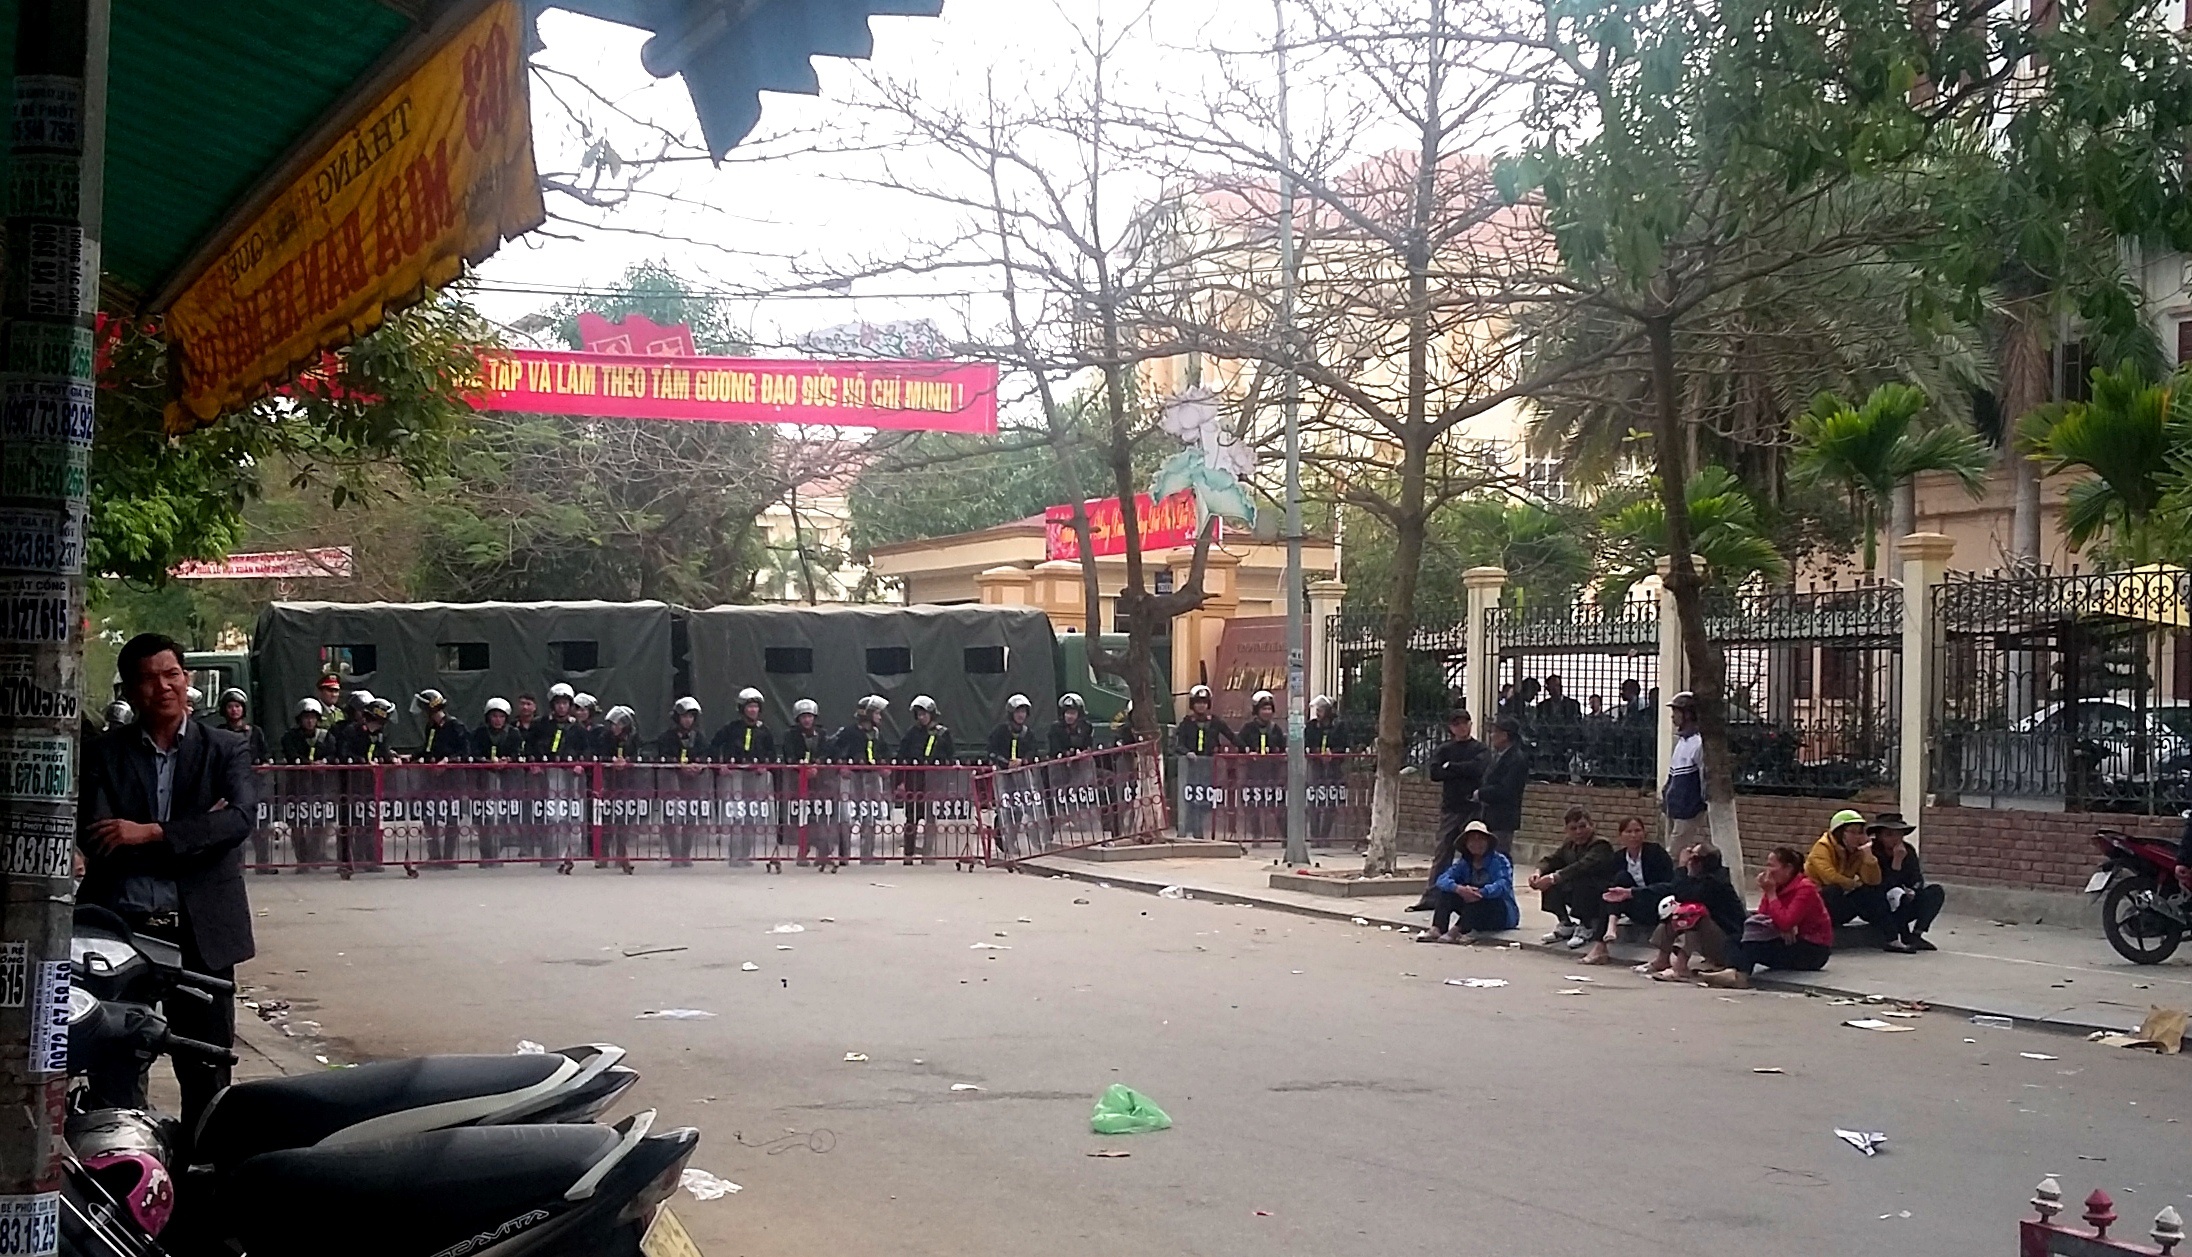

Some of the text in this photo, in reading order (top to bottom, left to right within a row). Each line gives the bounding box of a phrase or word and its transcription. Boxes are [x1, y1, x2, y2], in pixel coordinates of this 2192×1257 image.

[528, 358, 552, 394] VÀ
[556, 360, 596, 395] LÀM
[601, 366, 646, 398] THEO
[651, 361, 690, 400] TẤM
[695, 368, 756, 404] GƯƠNG
[761, 372, 797, 412] ĐẠO
[801, 363, 838, 407] ĐỨC
[871, 374, 901, 410] CHÍ
[906, 380, 952, 412] MINH
[2, 836, 72, 876] 5.83.15.25
